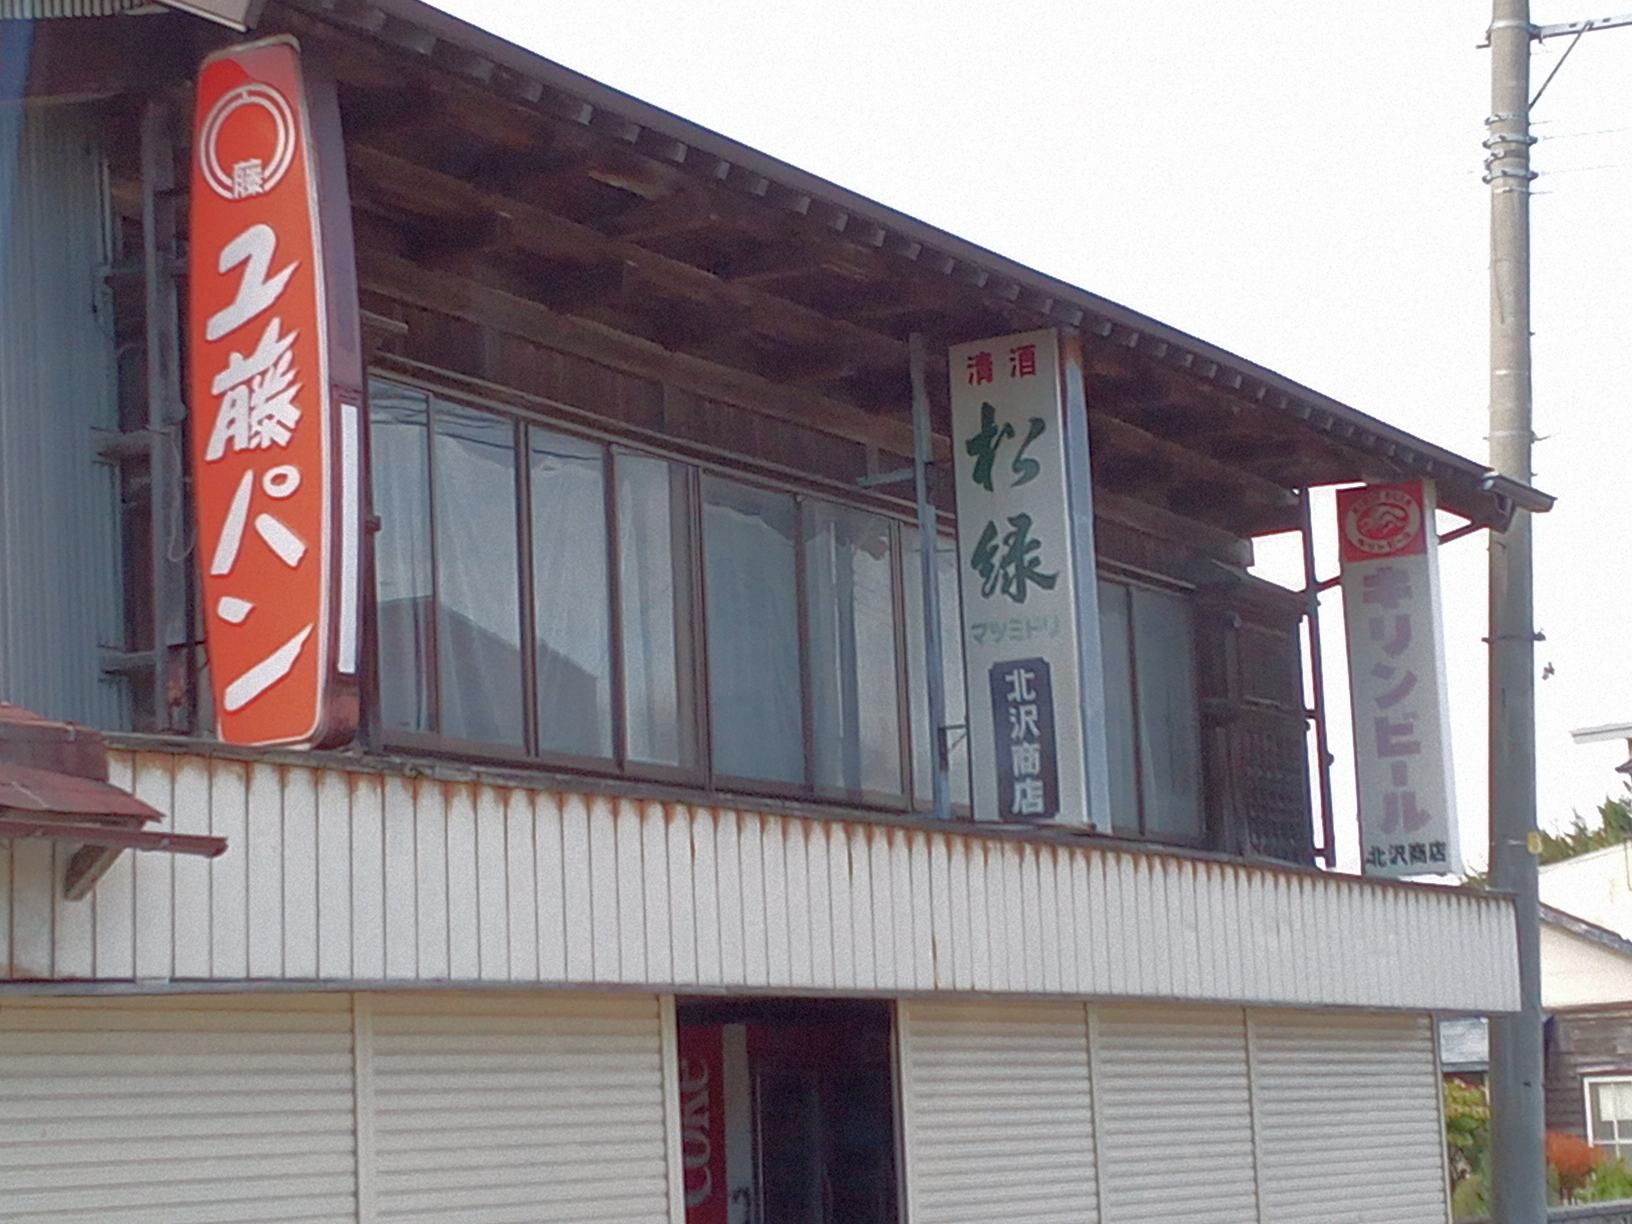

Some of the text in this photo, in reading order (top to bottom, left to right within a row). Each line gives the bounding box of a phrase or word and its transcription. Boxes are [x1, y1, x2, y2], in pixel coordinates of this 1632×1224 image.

[966, 344, 1037, 386] 清酒
[966, 401, 1059, 604] 松緑
[970, 616, 1060, 645] マツミドリ
[1004, 668, 1045, 817] 北沢商店
[1362, 566, 1432, 834] キリンビール
[1365, 840, 1447, 868] 北沢商店
